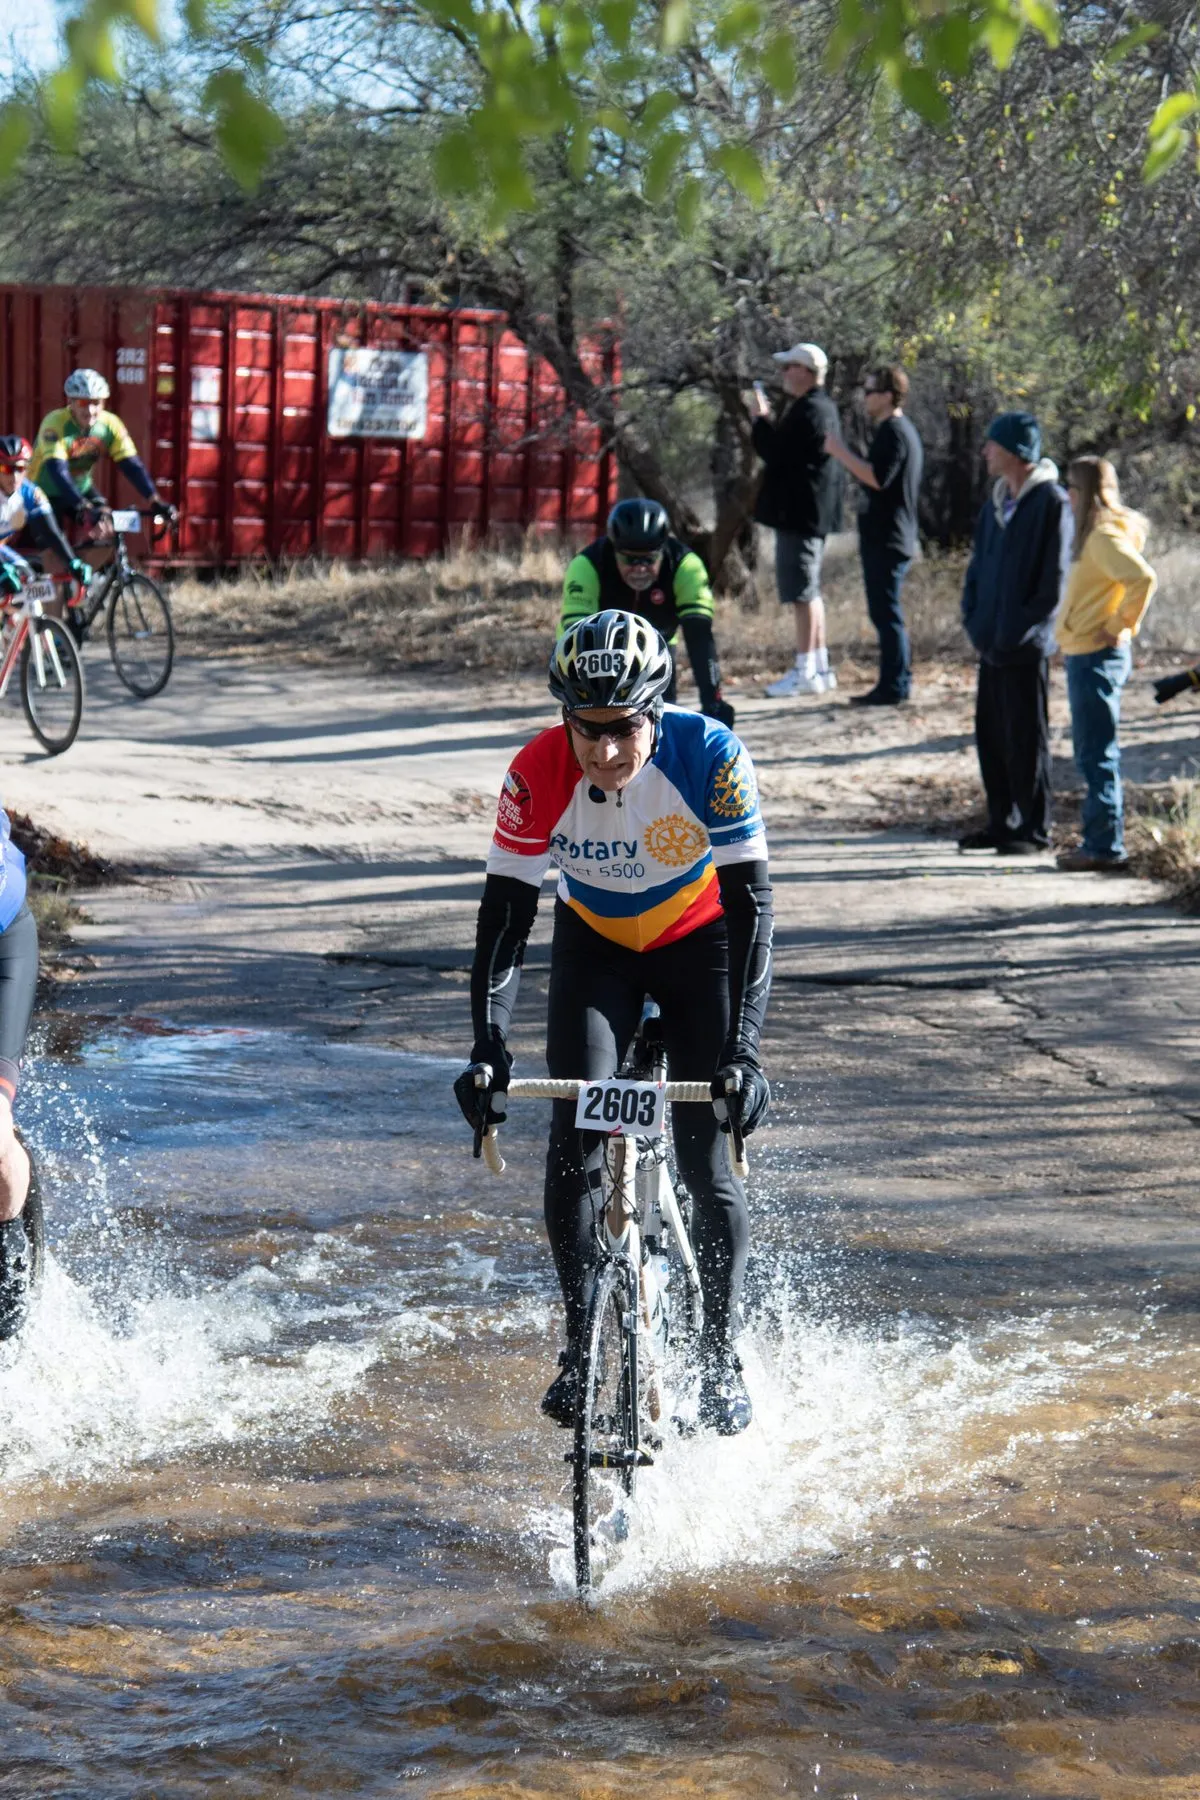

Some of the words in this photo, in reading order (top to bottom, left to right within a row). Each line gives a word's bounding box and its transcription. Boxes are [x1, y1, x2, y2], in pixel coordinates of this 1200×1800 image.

[577, 653, 626, 675] 2603
[502, 794, 521, 816] RIDE
[505, 807, 524, 825] END
[550, 833, 638, 861] Rotary
[599, 862, 645, 879] 5500
[583, 1086, 657, 1127] 2603
